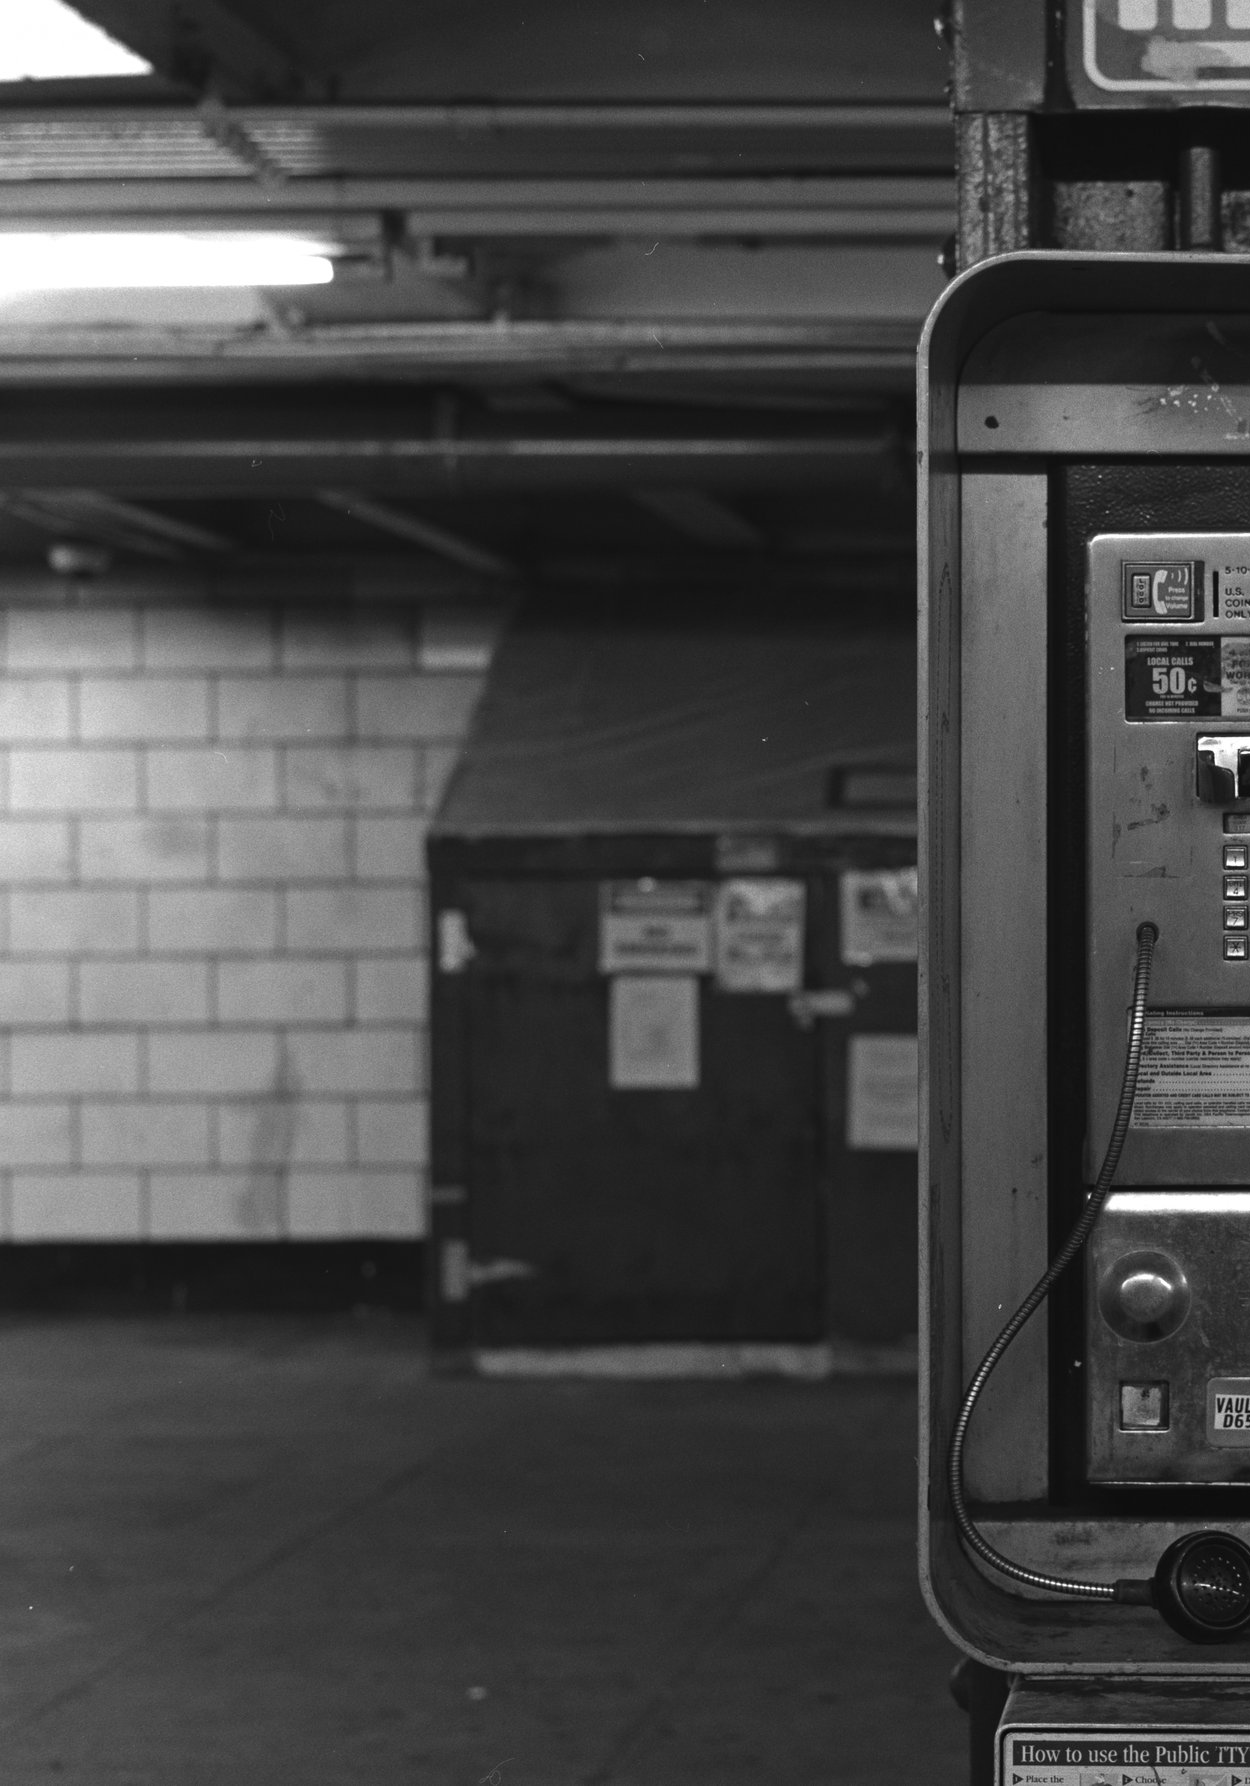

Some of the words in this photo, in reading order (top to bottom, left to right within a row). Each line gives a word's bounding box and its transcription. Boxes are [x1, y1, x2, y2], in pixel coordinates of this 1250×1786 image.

[1225, 588, 1244, 596] U.S.
[1147, 657, 1170, 666] LOCAL
[1171, 656, 1194, 666] CALLS
[1021, 1744, 1060, 1763] How
[1066, 1747, 1082, 1763] to
[1088, 1750, 1118, 1763] use
[1123, 1744, 1150, 1763] the
[1155, 1745, 1210, 1764] Public
[1026, 1775, 1048, 1783] Place
[1050, 1775, 1064, 1783] the
